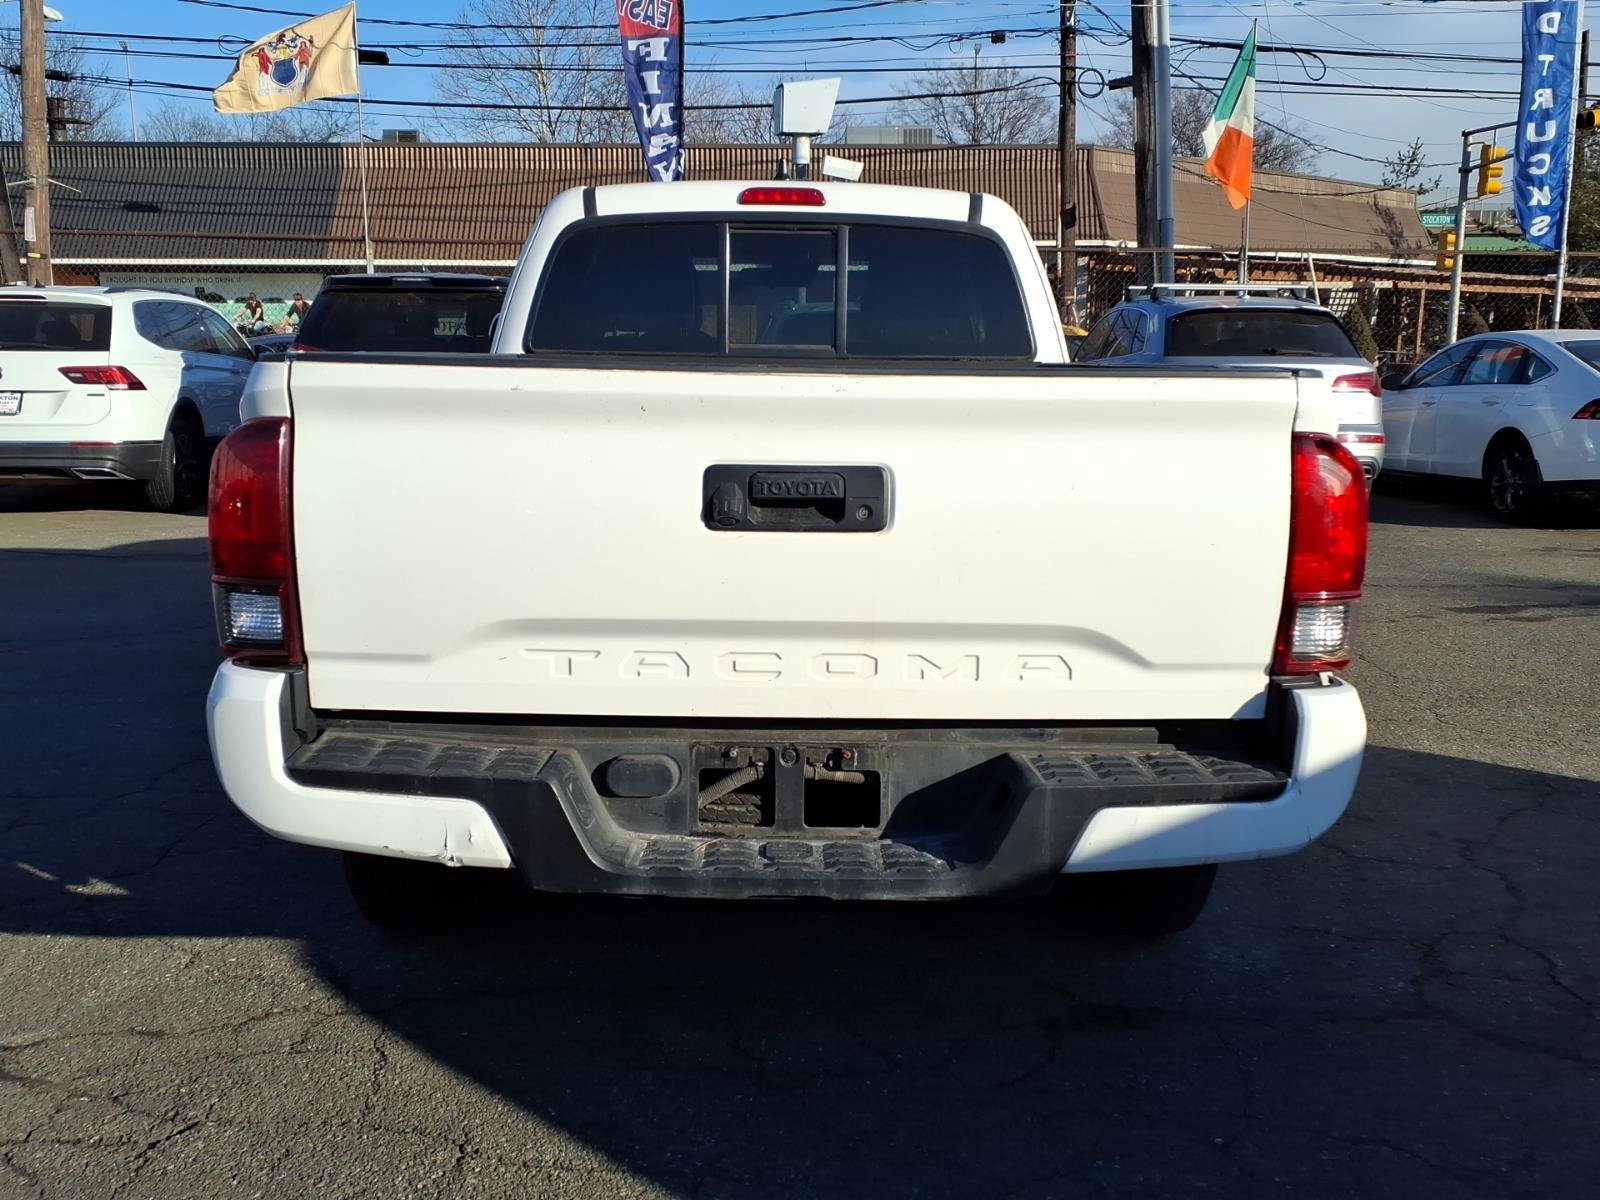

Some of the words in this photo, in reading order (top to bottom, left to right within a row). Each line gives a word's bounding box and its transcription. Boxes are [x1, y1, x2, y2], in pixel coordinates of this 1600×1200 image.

[1423, 215, 1450, 224] STOCKTON
[197, 276, 213, 284] WHO
[756, 479, 838, 497] TOYOTA
[519, 647, 1075, 682] TACOMA
